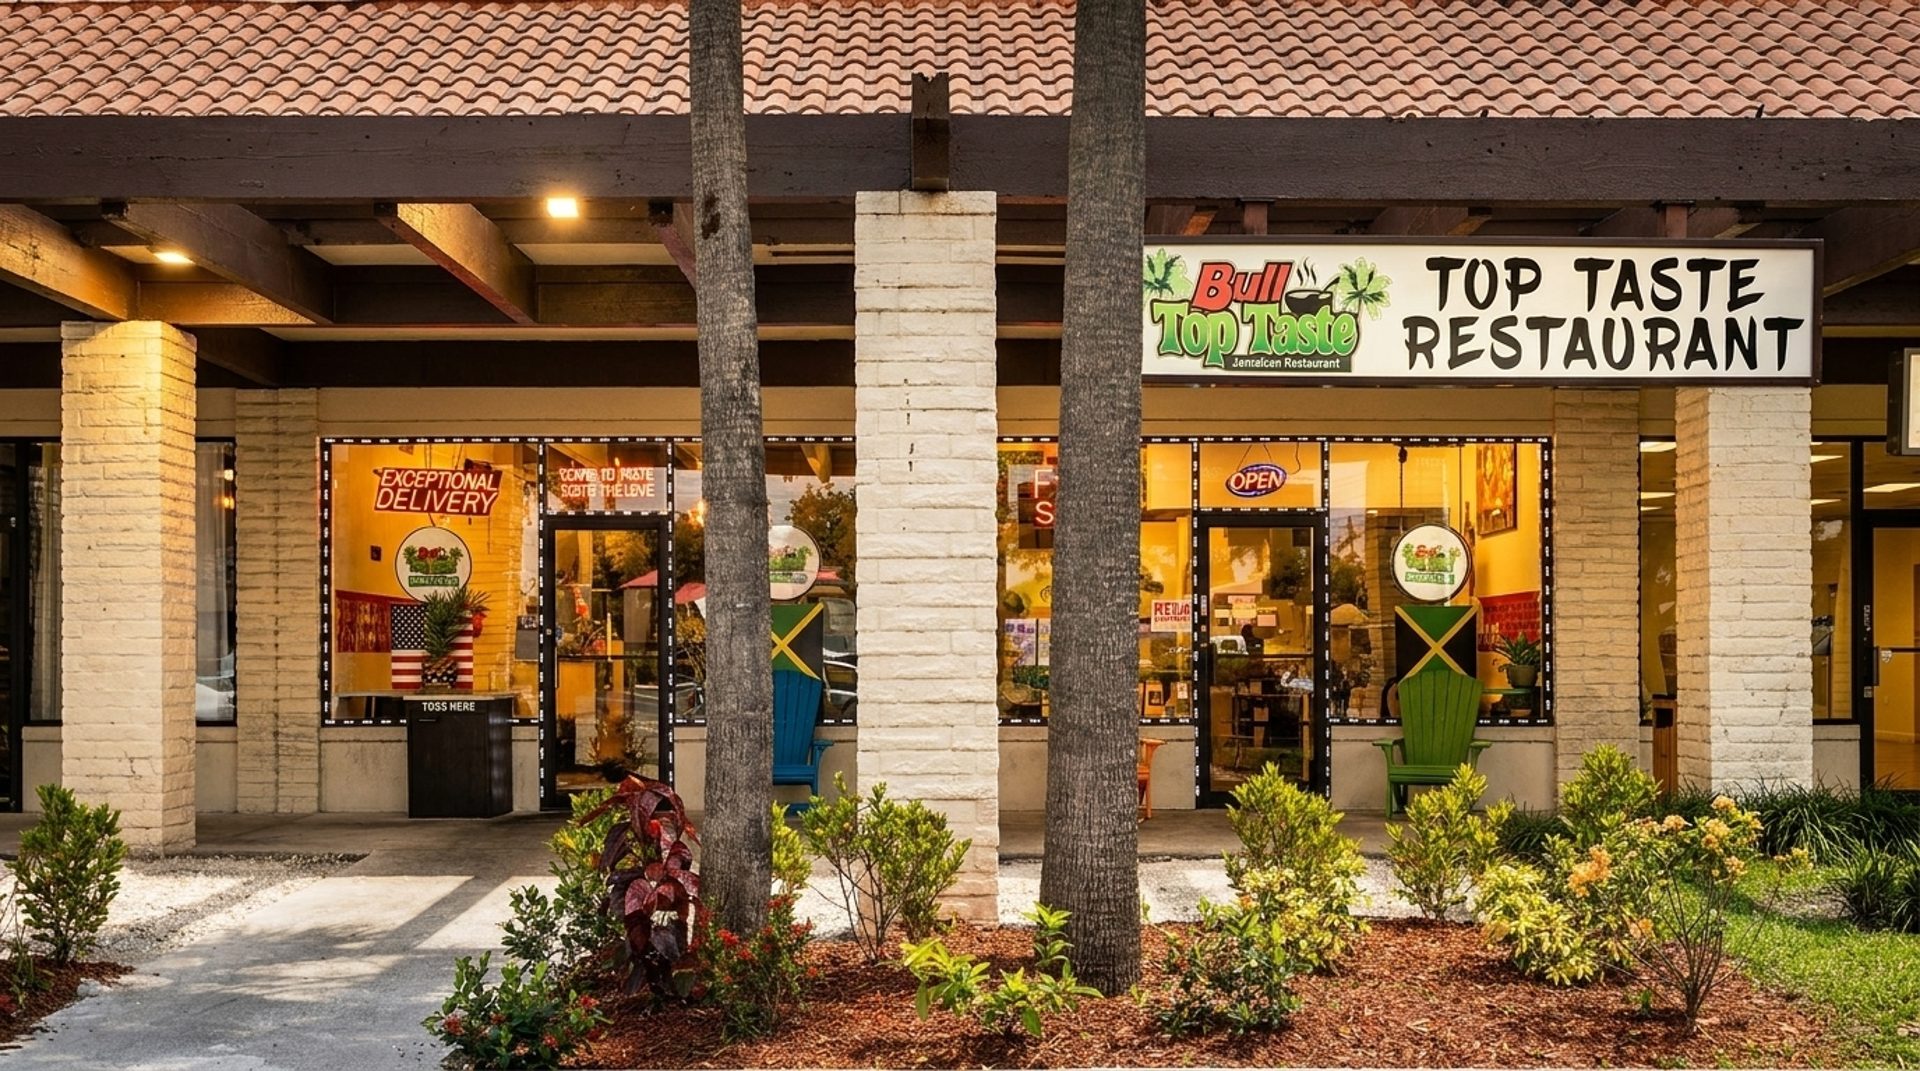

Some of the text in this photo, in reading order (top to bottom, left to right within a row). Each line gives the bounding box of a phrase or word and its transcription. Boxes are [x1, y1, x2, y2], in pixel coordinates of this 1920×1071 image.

[1191, 261, 1294, 312] Bull
[1426, 256, 1765, 312] TOP TASTE
[1150, 299, 1359, 368] Top Taste
[1402, 315, 1804, 371] RESTAURANT
[1284, 357, 1341, 368] Restaurant
[380, 468, 498, 491] EXCEPTIONAL
[1034, 468, 1059, 499] F
[1230, 470, 1281, 490] OPEN
[375, 487, 498, 514] DELIVERY
[421, 701, 476, 712] TOSS HERE
